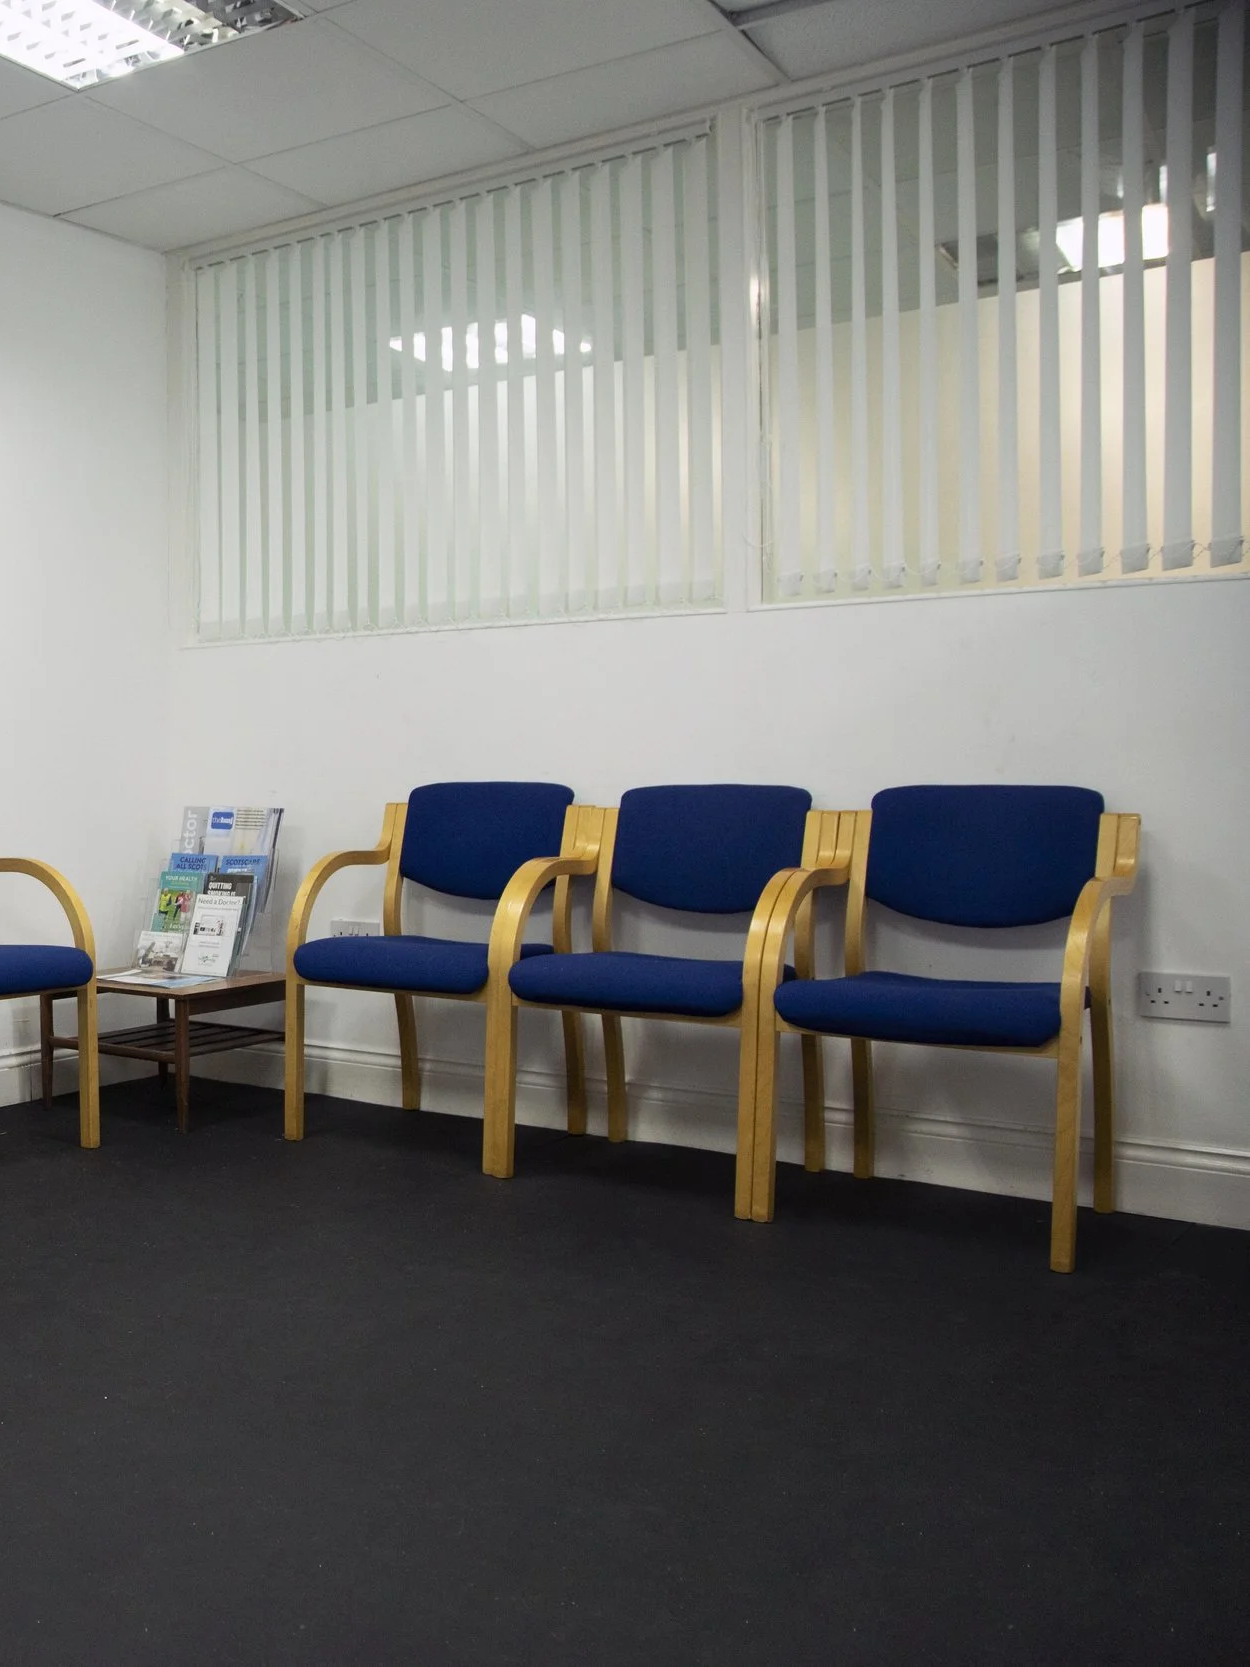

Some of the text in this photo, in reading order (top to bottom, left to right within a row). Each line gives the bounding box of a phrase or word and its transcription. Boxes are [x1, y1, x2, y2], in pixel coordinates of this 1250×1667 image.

[180, 856, 206, 864] CALLING
[208, 882, 232, 890] QUITTING
[218, 898, 241, 906] Doctor?
